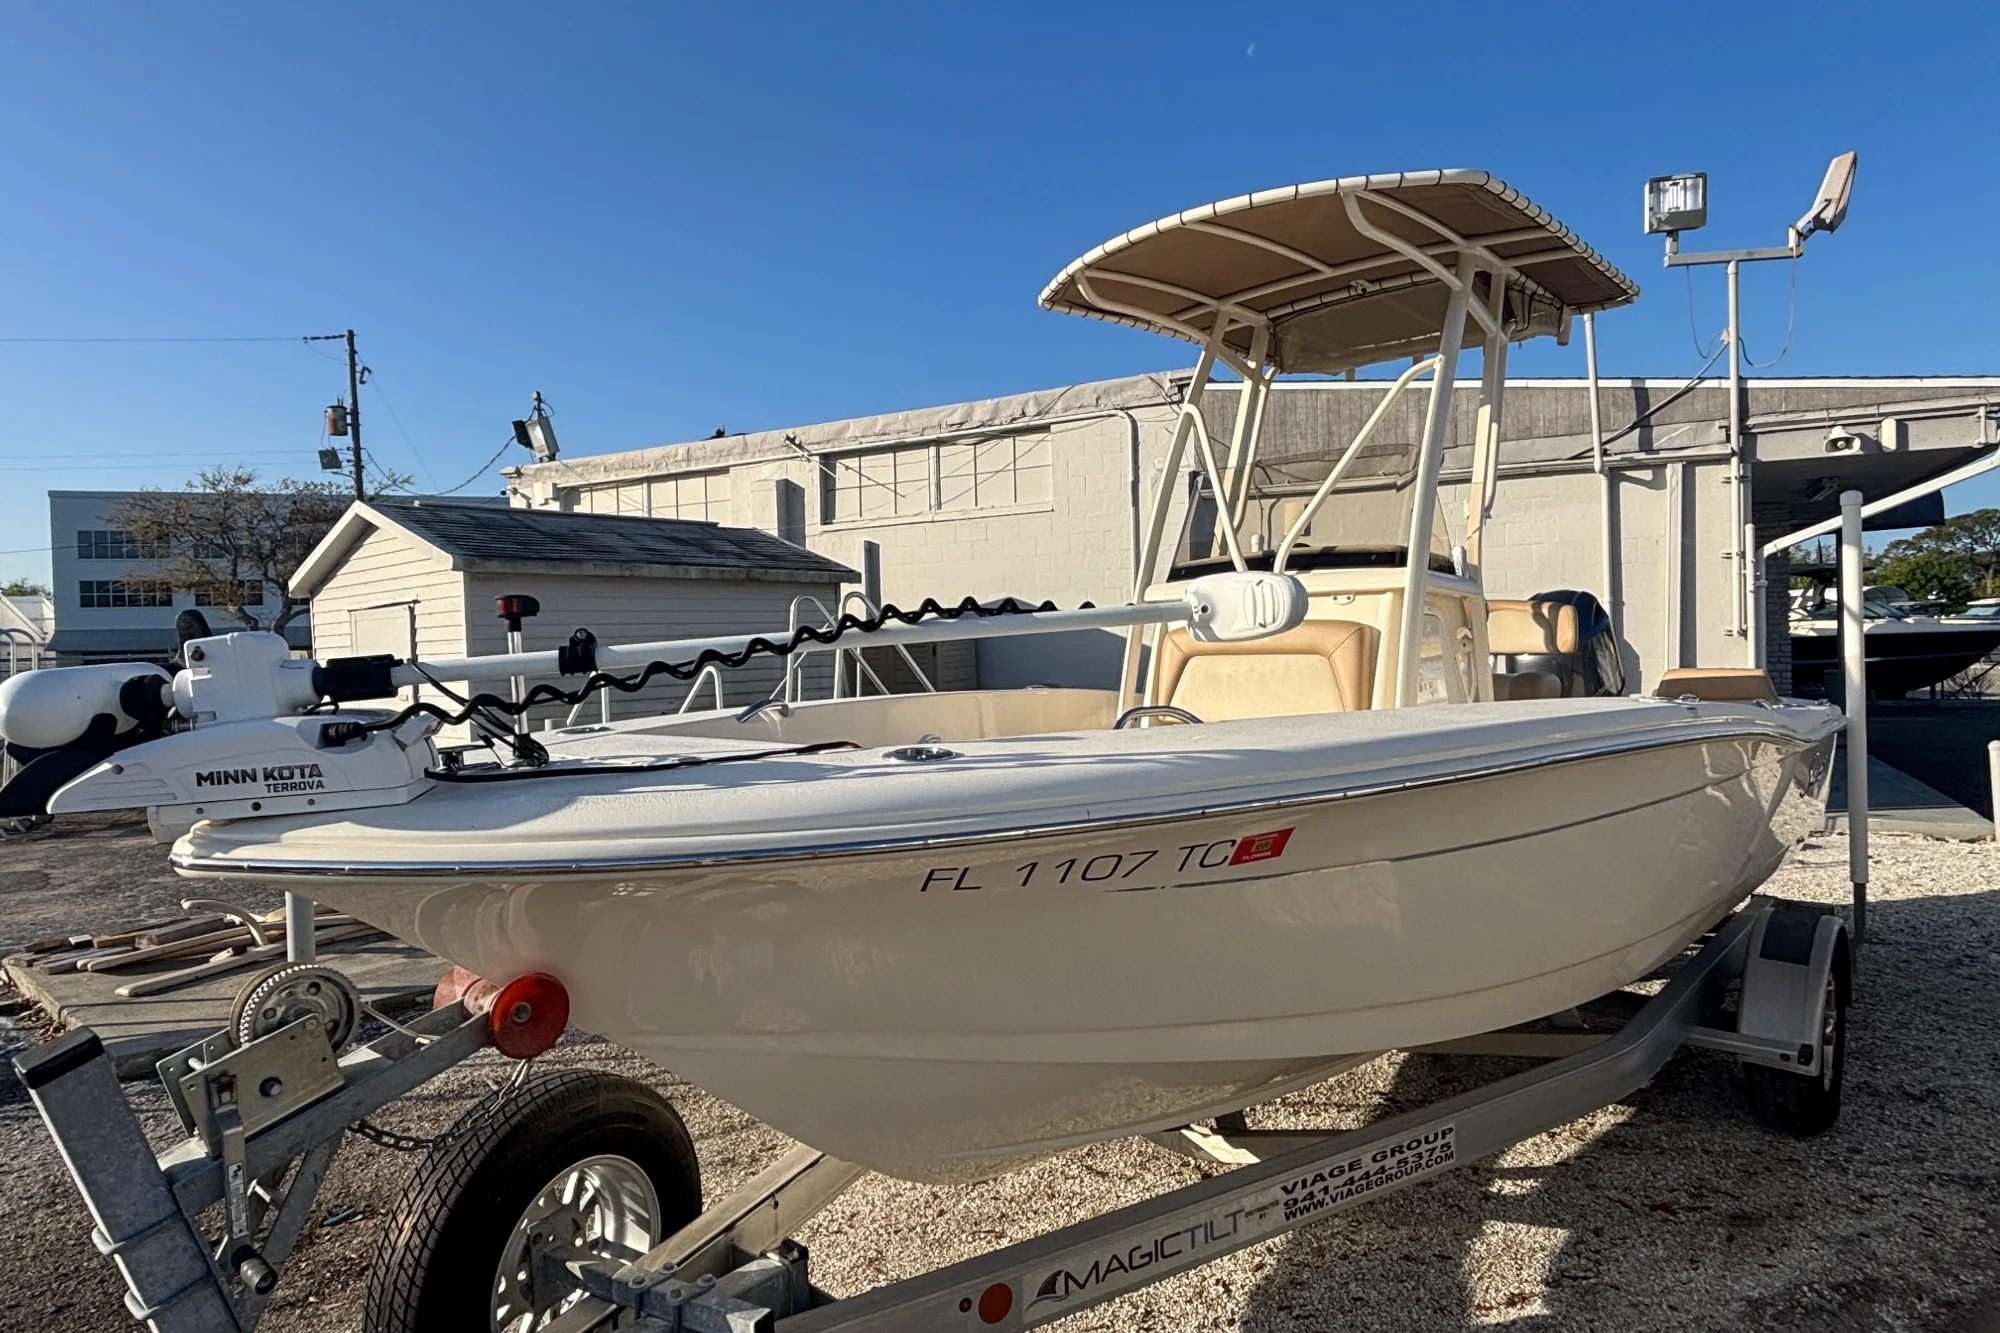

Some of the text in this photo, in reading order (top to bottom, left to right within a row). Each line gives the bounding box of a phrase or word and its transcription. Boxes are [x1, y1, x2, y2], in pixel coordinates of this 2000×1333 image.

[196, 763, 323, 787] MINN KOTA
[264, 779, 325, 793] TERROVA
[920, 839, 1237, 892] FL 1107 TC
[1281, 1126, 1454, 1195] VIAGE GROUP
[1283, 1141, 1452, 1210] 941-444-5375
[1283, 1150, 1455, 1222] WWW.VIAGEGROUP.COM
[1064, 1208, 1245, 1295] MAGICTILT
